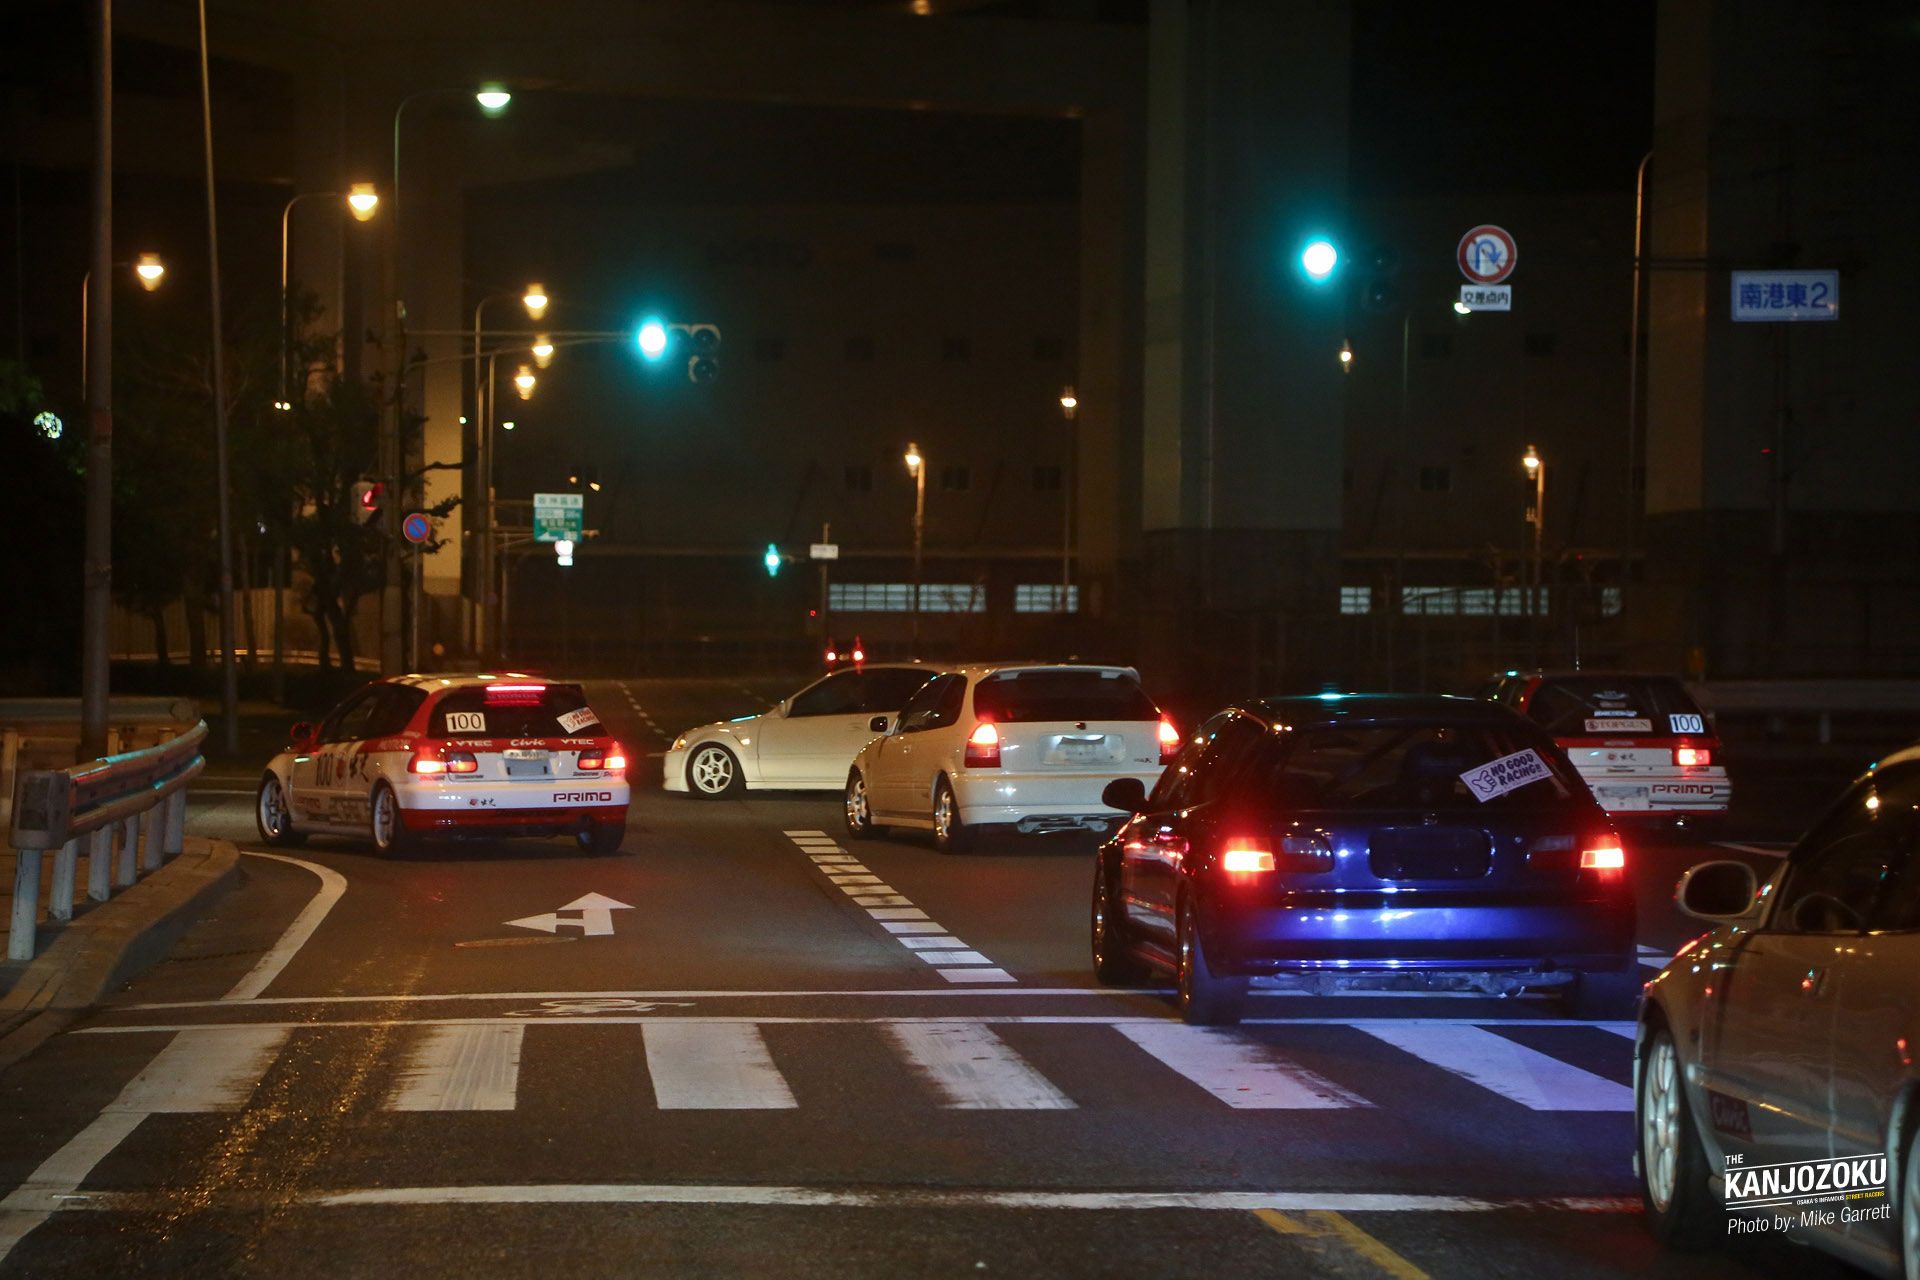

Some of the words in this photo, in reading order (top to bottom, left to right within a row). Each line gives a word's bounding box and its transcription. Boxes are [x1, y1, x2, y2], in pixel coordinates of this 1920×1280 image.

[1463, 290, 1510, 306] 交差点内
[1739, 282, 1830, 309] 南港東2
[449, 713, 483, 730] 100
[1671, 715, 1701, 732] 100
[455, 739, 493, 747] VTEC
[510, 738, 547, 747] Civic
[315, 753, 334, 786] 100
[1490, 763, 1506, 777] NO
[1505, 753, 1534, 771] GOOD
[553, 791, 612, 803] PRIMO
[1652, 784, 1714, 795] PRIMO
